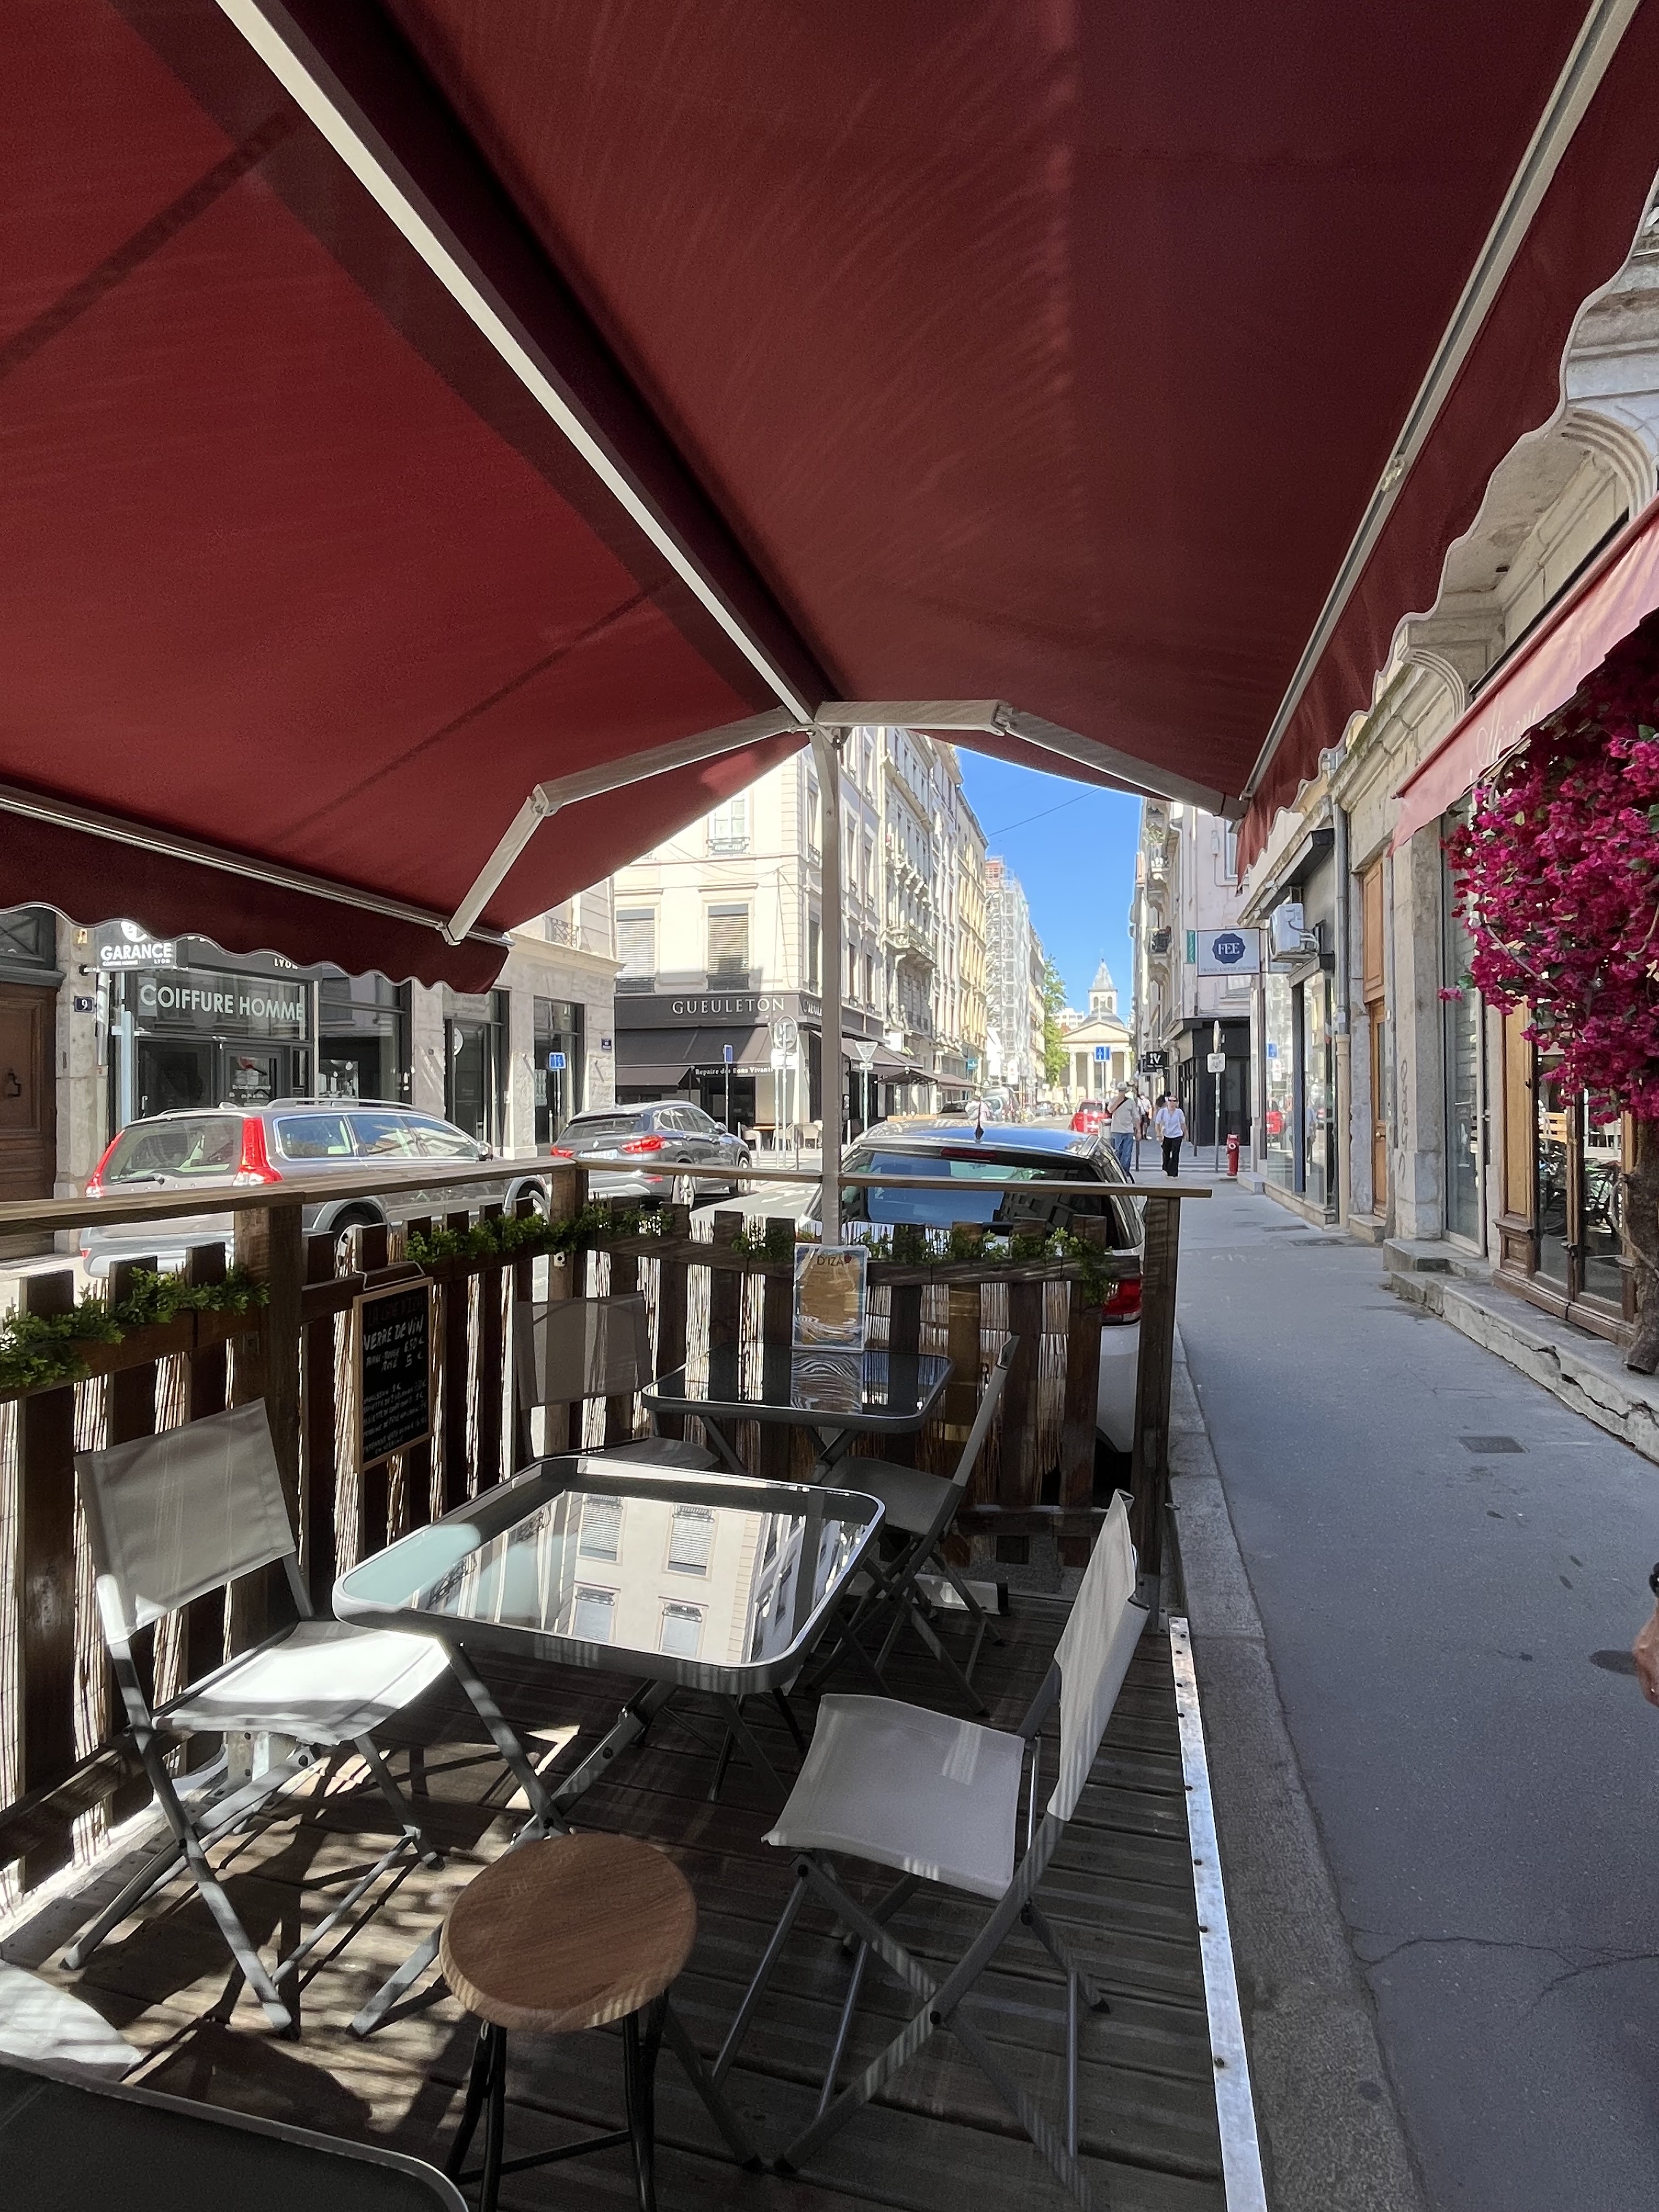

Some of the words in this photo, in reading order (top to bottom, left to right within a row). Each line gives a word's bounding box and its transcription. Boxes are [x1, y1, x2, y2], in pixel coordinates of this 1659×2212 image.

[100, 943, 172, 961] GARANCE
[1218, 943, 1240, 955] FEE
[81, 998, 88, 1010] 9
[140, 984, 234, 1014] COIFFURE
[239, 996, 304, 1020] HOMME
[672, 997, 785, 1014] GUEULETON
[695, 1068, 719, 1076] Repaire
[363, 1326, 393, 1351] VERRE
[394, 1322, 406, 1340] DE
[405, 1353, 412, 1368] 5
